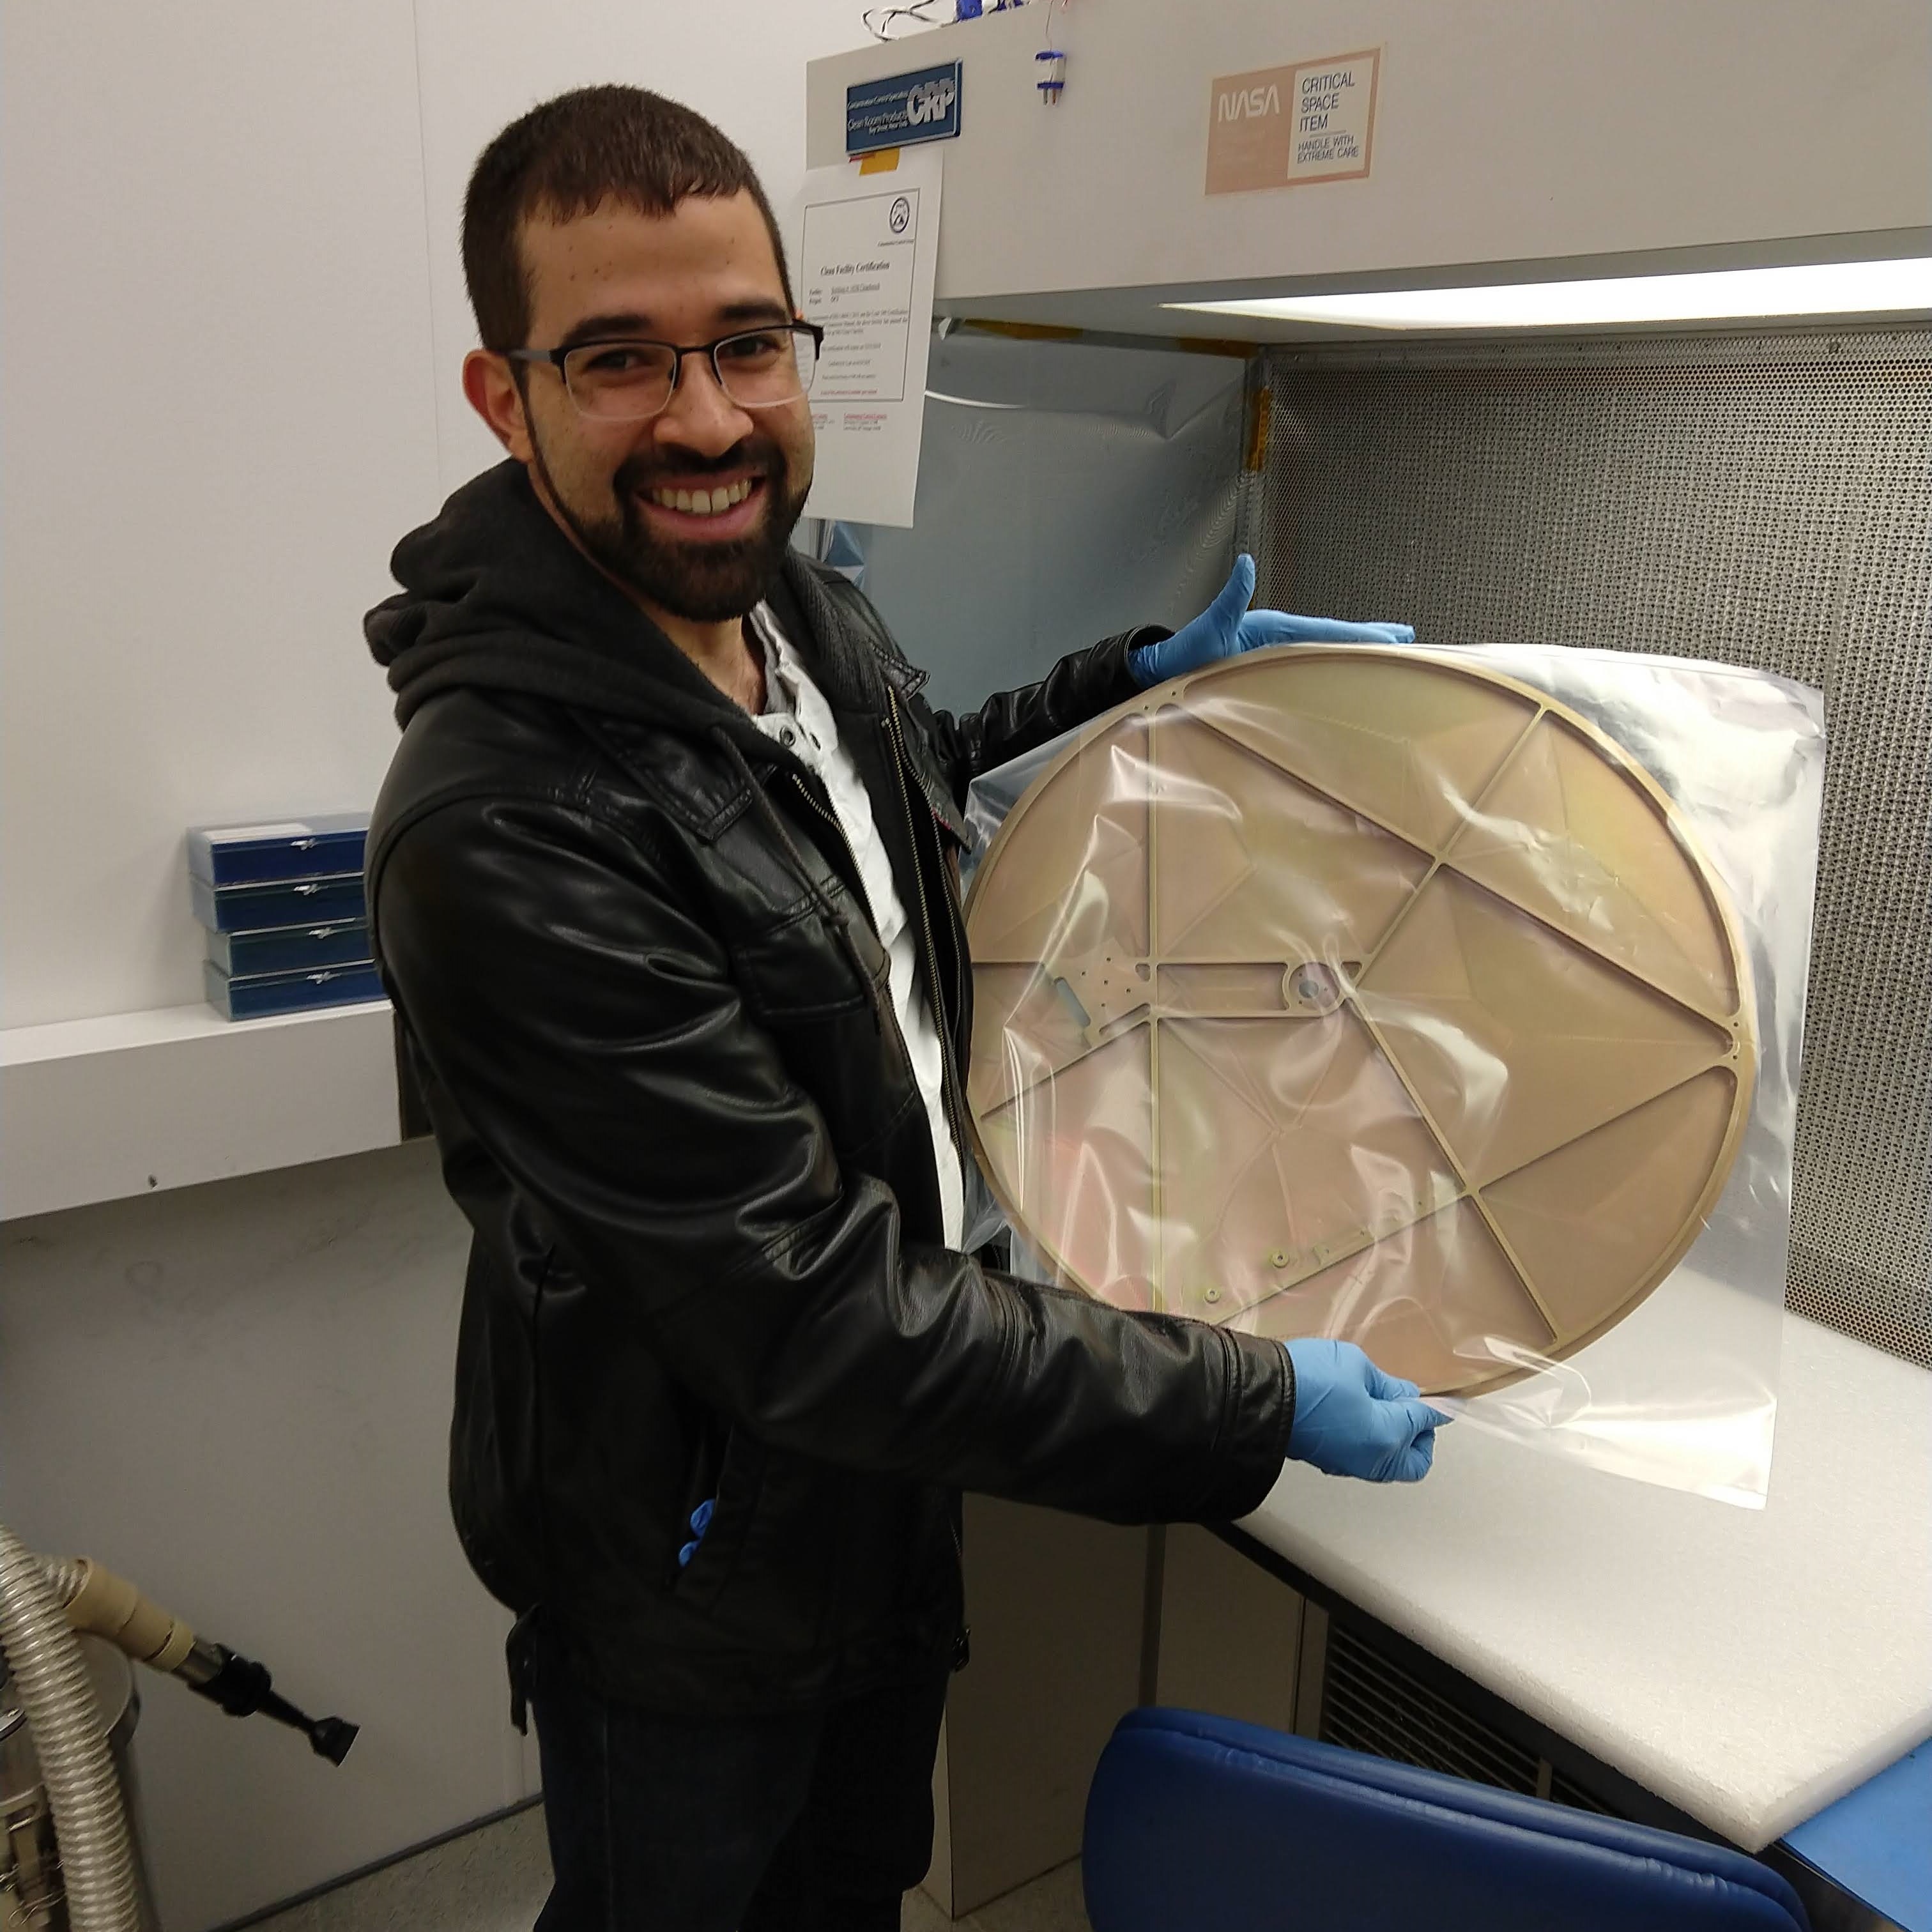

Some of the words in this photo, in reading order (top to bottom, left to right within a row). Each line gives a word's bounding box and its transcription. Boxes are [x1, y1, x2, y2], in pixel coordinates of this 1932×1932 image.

[1302, 72, 1355, 95] CRITICAL
[907, 78, 955, 126] CRP
[1218, 84, 1280, 123] NASA
[1301, 93, 1340, 114] SPACE
[1299, 115, 1328, 132] ITEM
[1298, 137, 1330, 153] HANDLE
[1333, 134, 1354, 146] WITH
[1297, 149, 1334, 164] EXTREME
[1337, 146, 1359, 158] CARE
